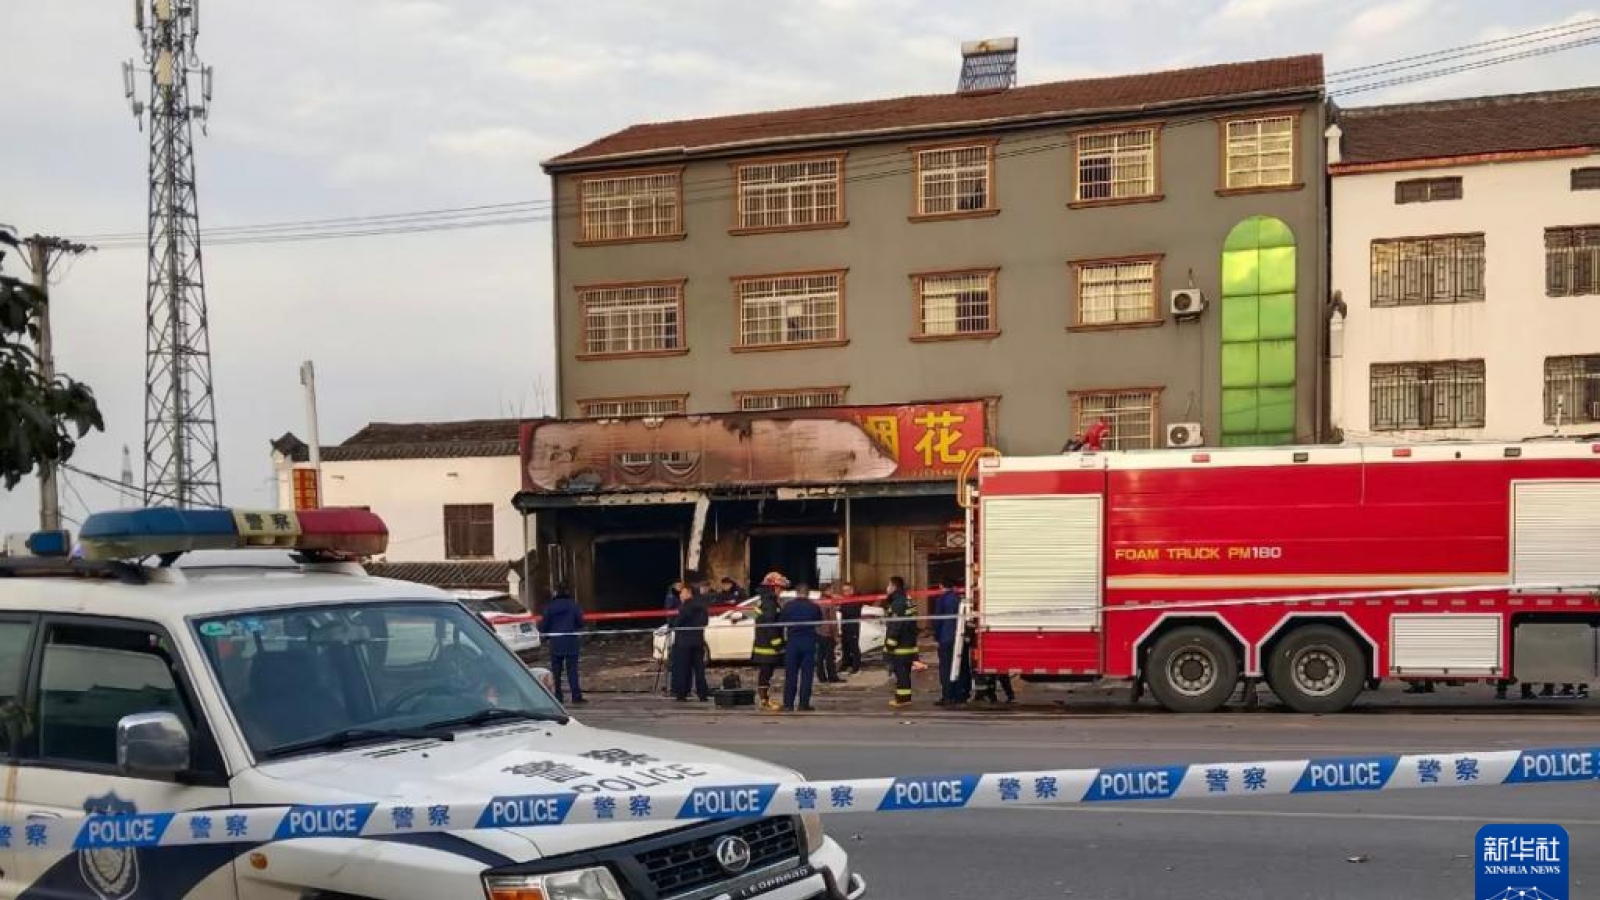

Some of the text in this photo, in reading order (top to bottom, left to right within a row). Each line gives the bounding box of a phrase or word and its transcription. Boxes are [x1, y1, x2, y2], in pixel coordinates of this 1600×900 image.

[244, 513, 291, 531] 警察
[1115, 546, 1282, 560] FOAM TRUCK PM180
[501, 748, 661, 783] 警察
[89, 819, 155, 842] POLICE
[190, 815, 248, 838] 警察
[290, 809, 357, 833] POLICE
[391, 805, 450, 829] 警察
[492, 799, 559, 823] POLICE
[593, 795, 652, 819] 警察
[693, 789, 760, 814] POLICE
[795, 786, 854, 809] 警察
[895, 781, 962, 804] POLICE
[997, 776, 1058, 800] 警察
[1100, 771, 1169, 796] POLICE
[1205, 767, 1267, 792] 警察
[1310, 762, 1381, 787] POLICE
[1417, 758, 1479, 783] 警察
[1522, 753, 1593, 777] POLICE
